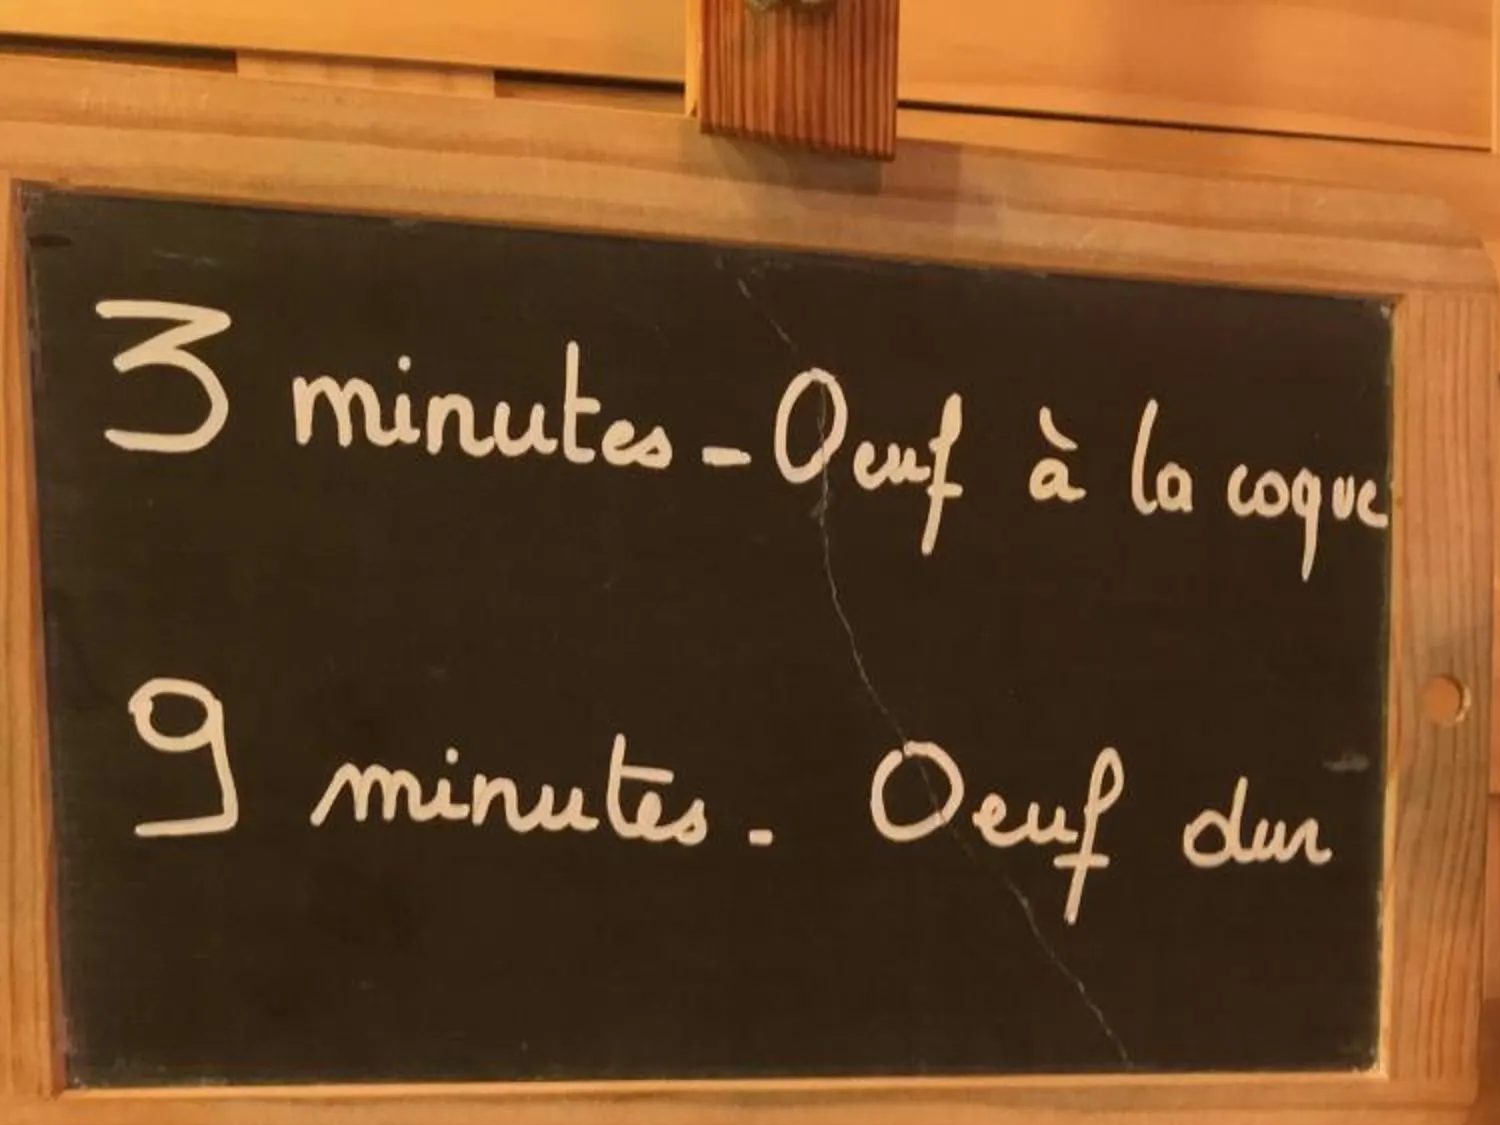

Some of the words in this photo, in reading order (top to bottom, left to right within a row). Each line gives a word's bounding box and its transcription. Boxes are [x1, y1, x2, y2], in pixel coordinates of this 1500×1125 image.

[96, 300, 231, 452] 3
[293, 341, 672, 468] minutes
[1030, 407, 1086, 501] à
[1132, 400, 1192, 514] la
[1228, 464, 1388, 580] coque
[128, 678, 238, 836] 9
[311, 734, 707, 845] minutes
[1184, 777, 1332, 867] dur
